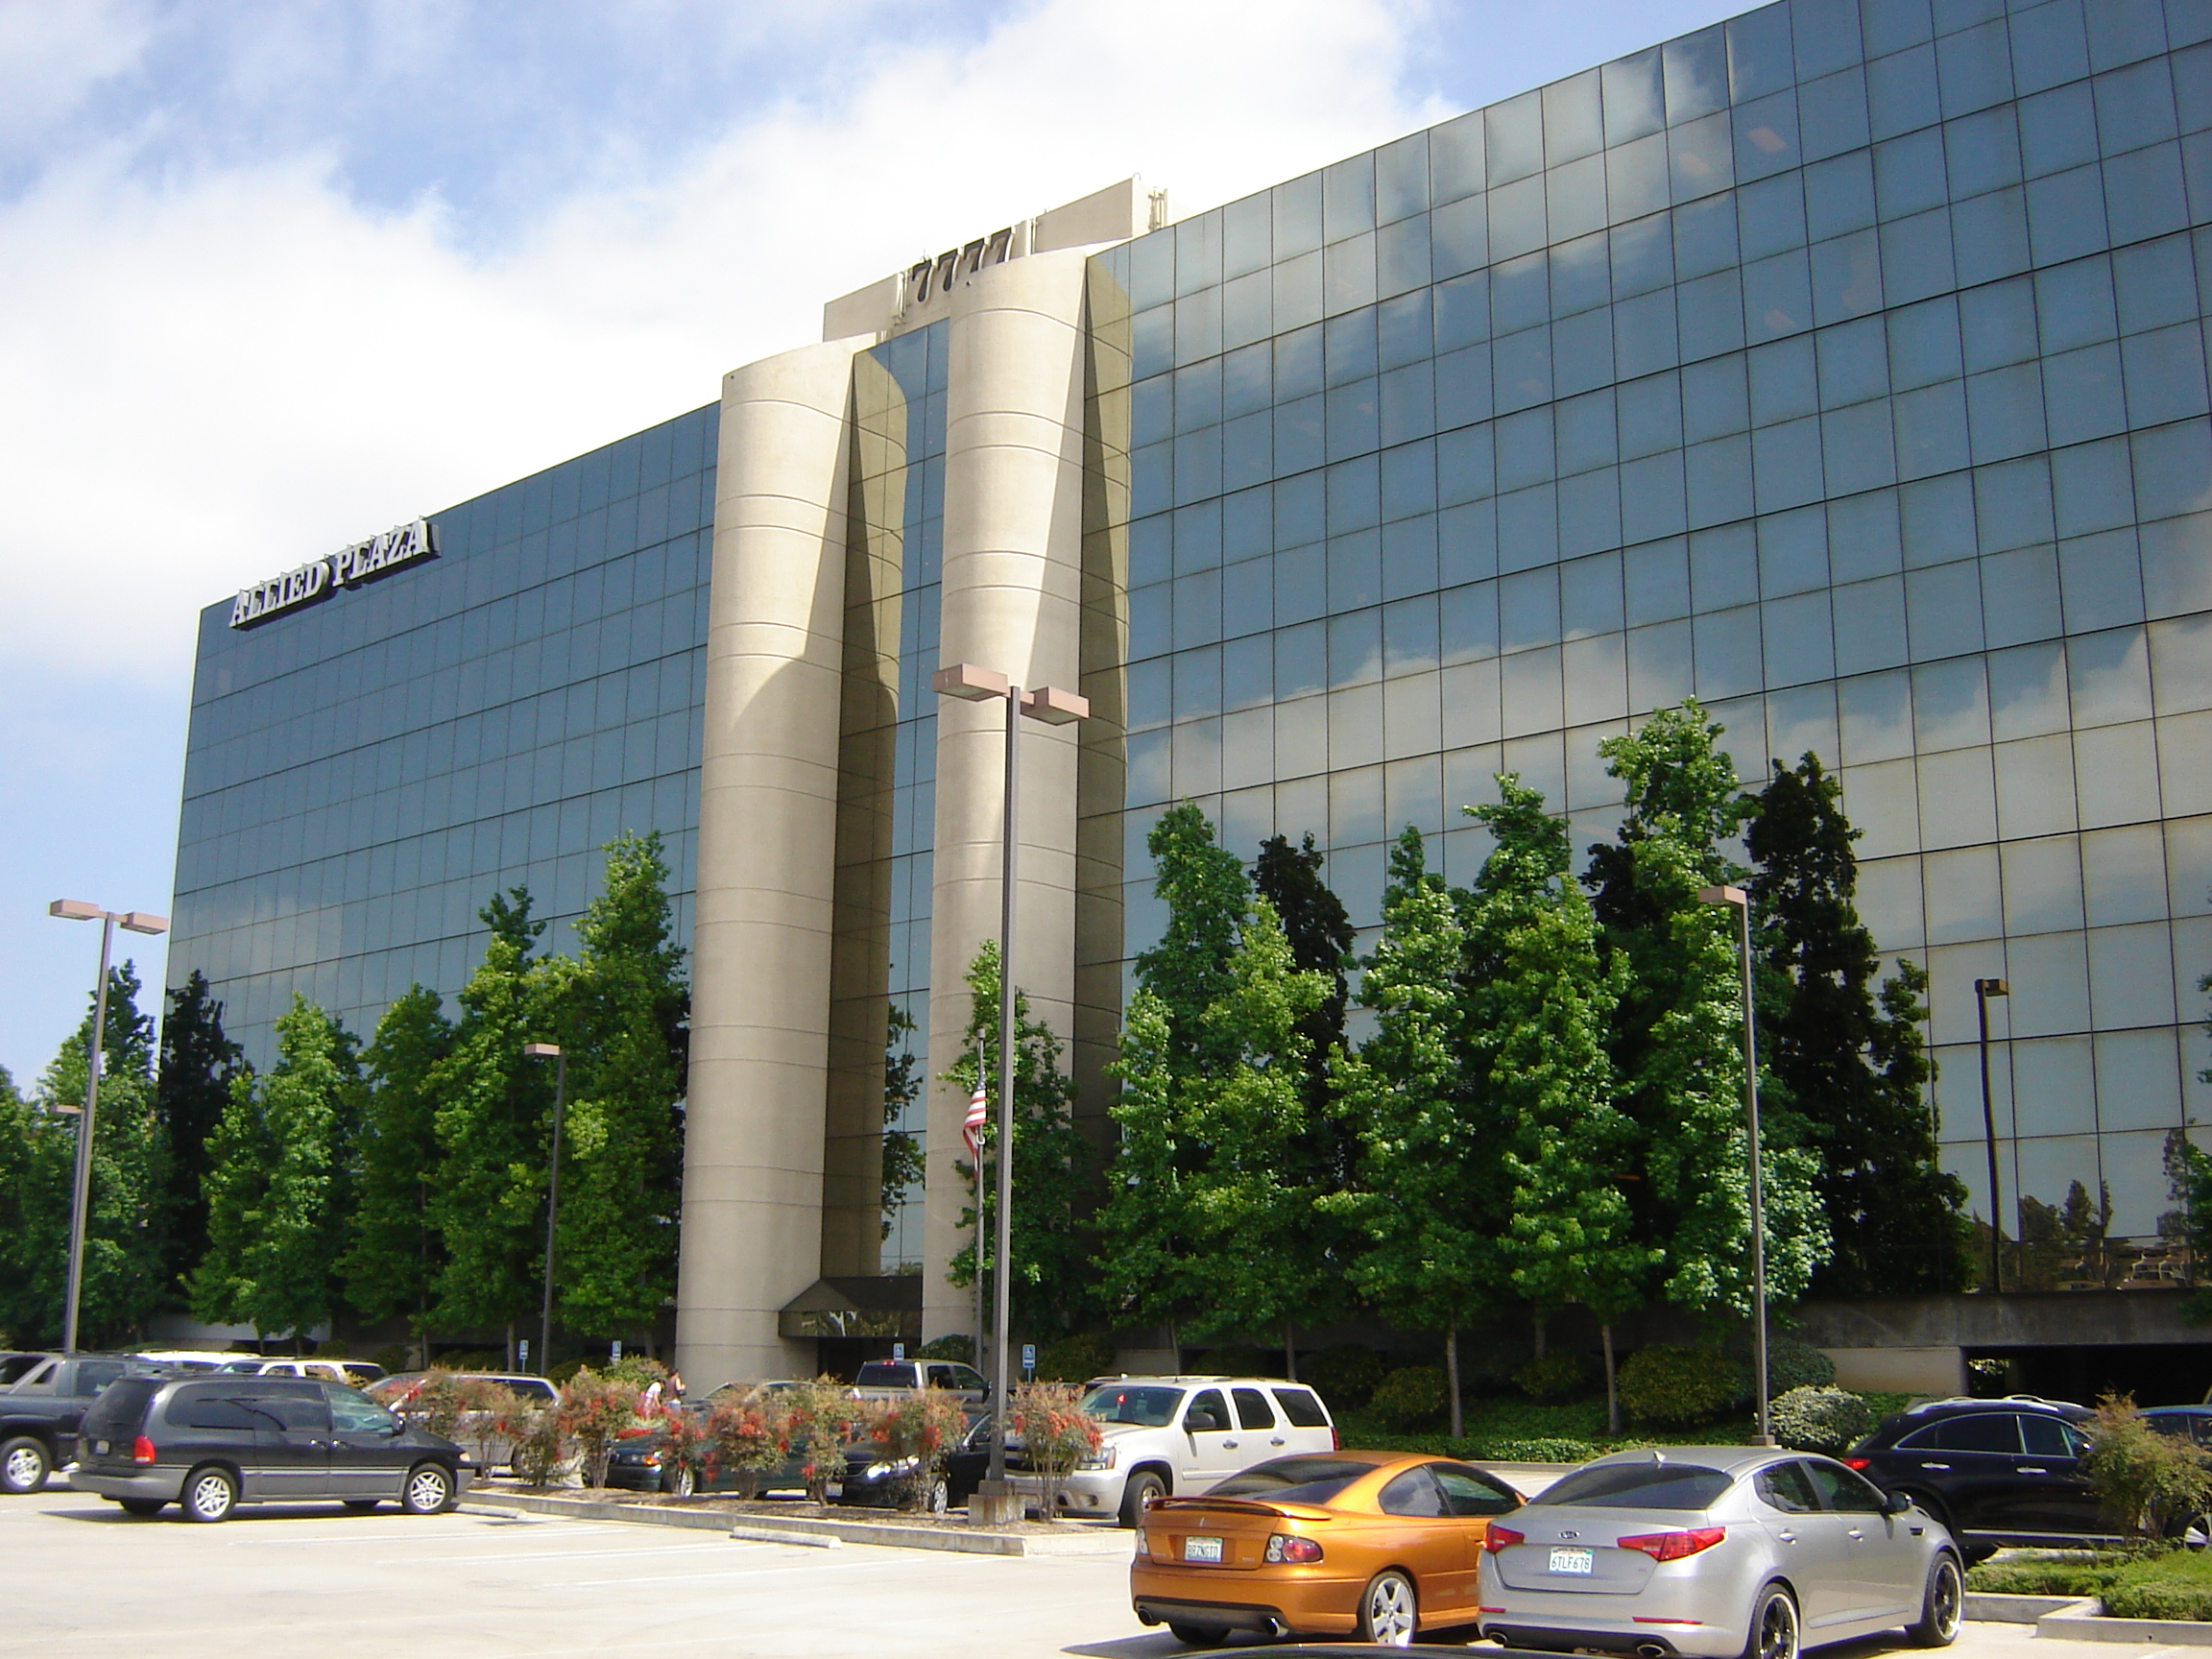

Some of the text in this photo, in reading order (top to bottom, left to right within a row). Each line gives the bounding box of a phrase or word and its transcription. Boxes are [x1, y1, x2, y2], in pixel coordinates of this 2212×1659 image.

[911, 226, 1014, 302] 7777
[229, 519, 430, 628] ALLIED PLAZA
[1551, 1555, 1590, 1570] 6TLF678
